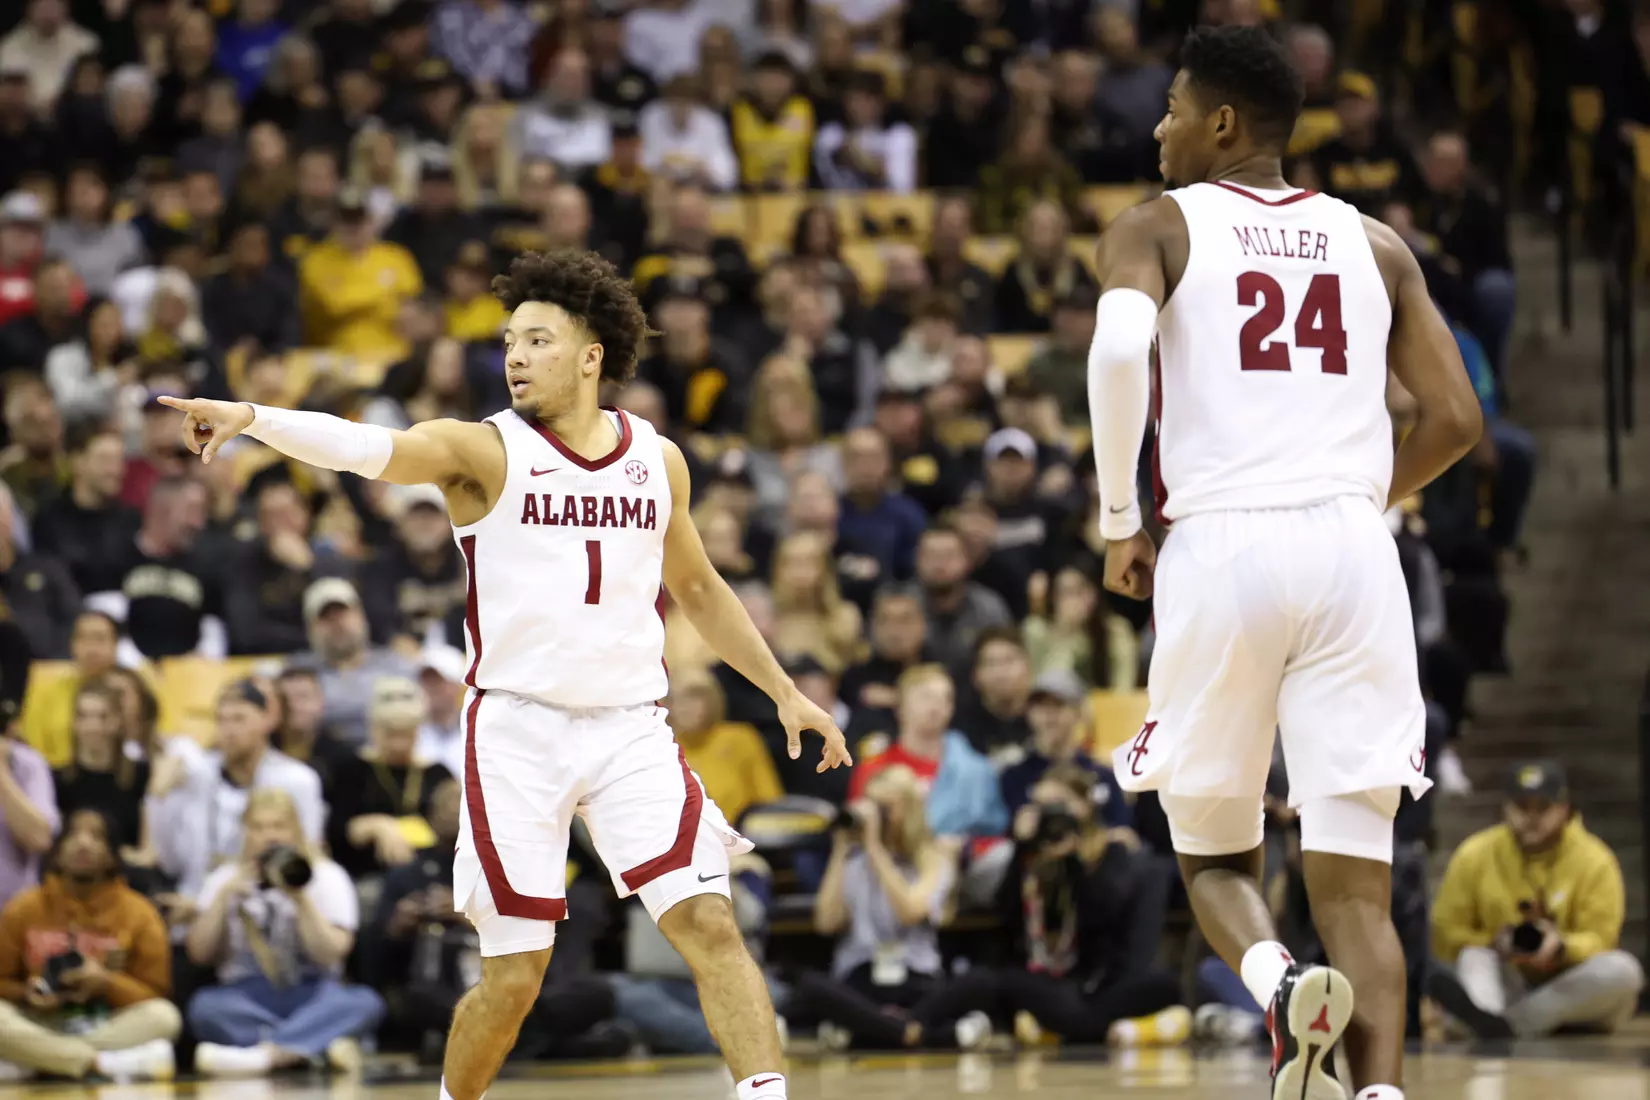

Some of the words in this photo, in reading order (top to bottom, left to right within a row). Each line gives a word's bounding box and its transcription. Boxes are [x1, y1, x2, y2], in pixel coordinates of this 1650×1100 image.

[1233, 226, 1329, 262] MILLER
[1236, 270, 1348, 376] 24
[626, 460, 648, 484] SEC
[521, 493, 657, 531] ALABAMA
[584, 540, 602, 605] 1
